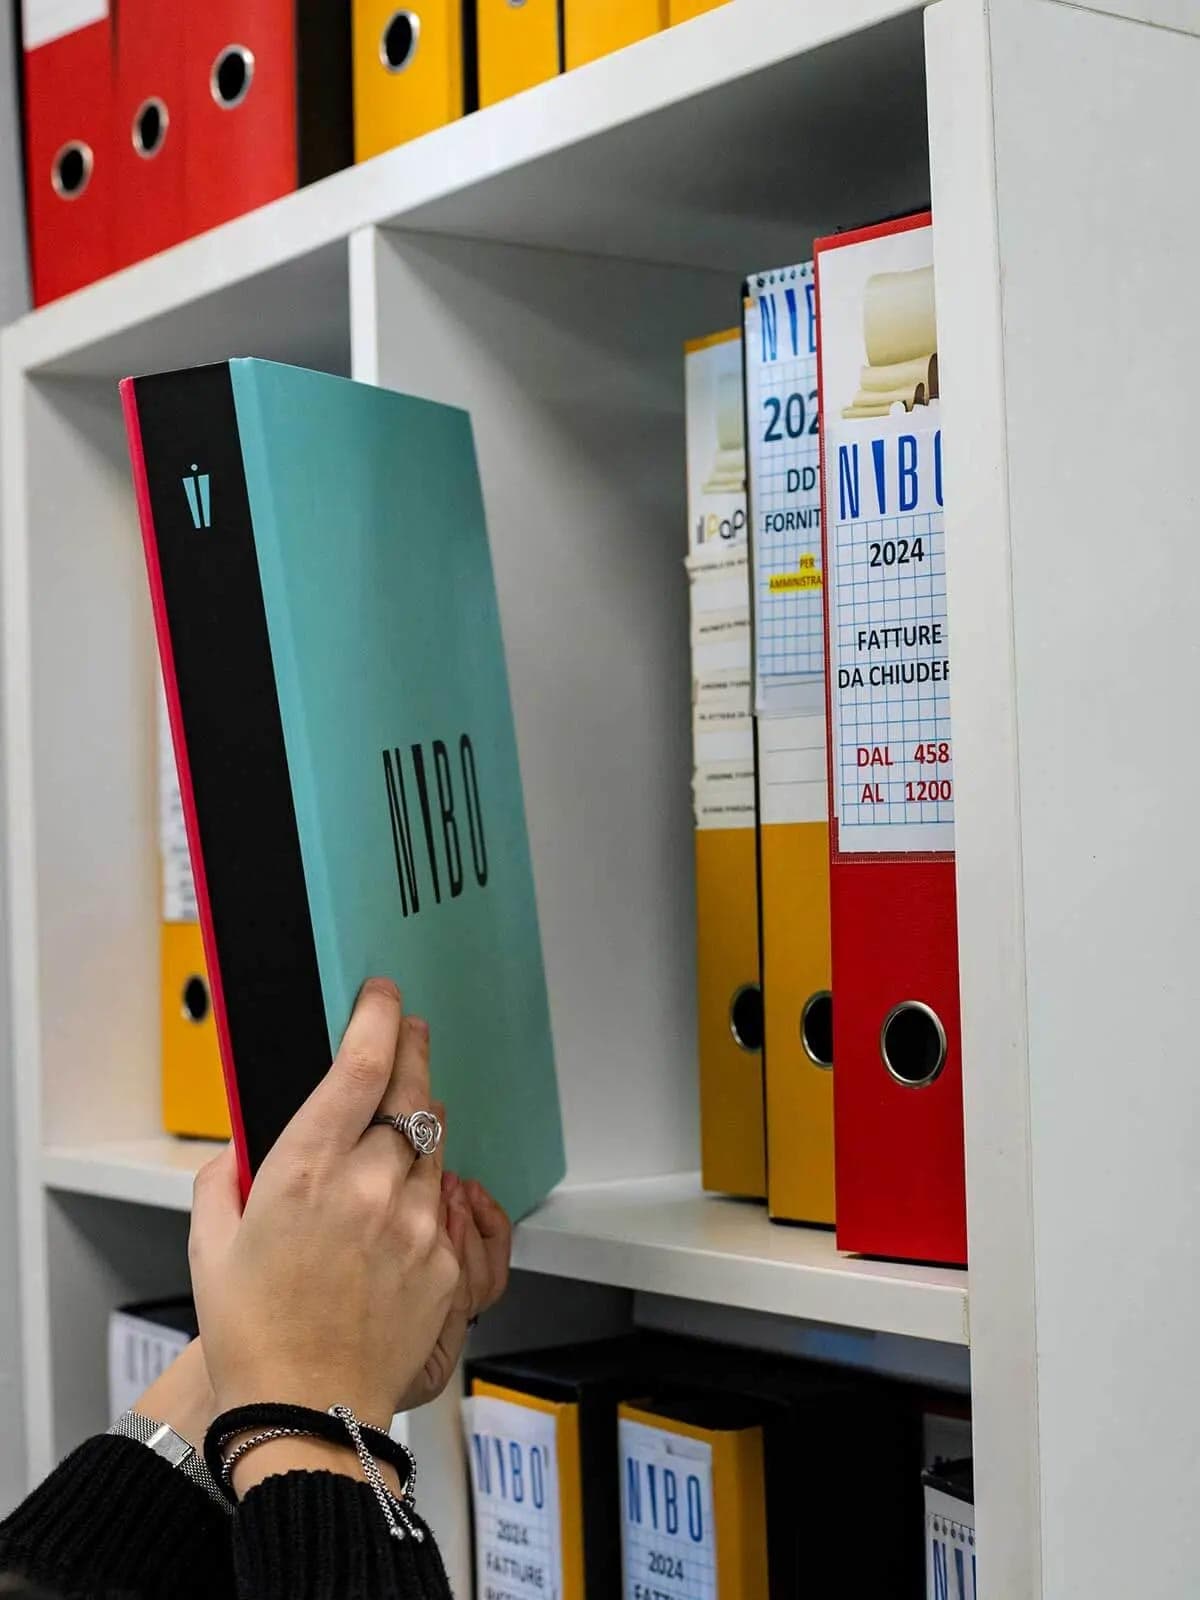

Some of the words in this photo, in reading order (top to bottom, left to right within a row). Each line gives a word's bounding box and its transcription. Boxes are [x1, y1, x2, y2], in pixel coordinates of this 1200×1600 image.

[786, 464, 821, 493] DD
[799, 557, 816, 569] PER
[869, 537, 925, 567] 2024
[857, 623, 942, 651] FATTURE
[838, 667, 864, 689] DA
[857, 746, 894, 767] DAL
[914, 742, 950, 764] 458
[861, 783, 884, 803] AL
[905, 780, 952, 802] 1200
[382, 733, 489, 918] NIBO
[473, 1433, 545, 1509] NIBO
[627, 1456, 703, 1542] NIBO
[647, 1552, 685, 1581] 2024
[932, 1538, 977, 1600] NI
